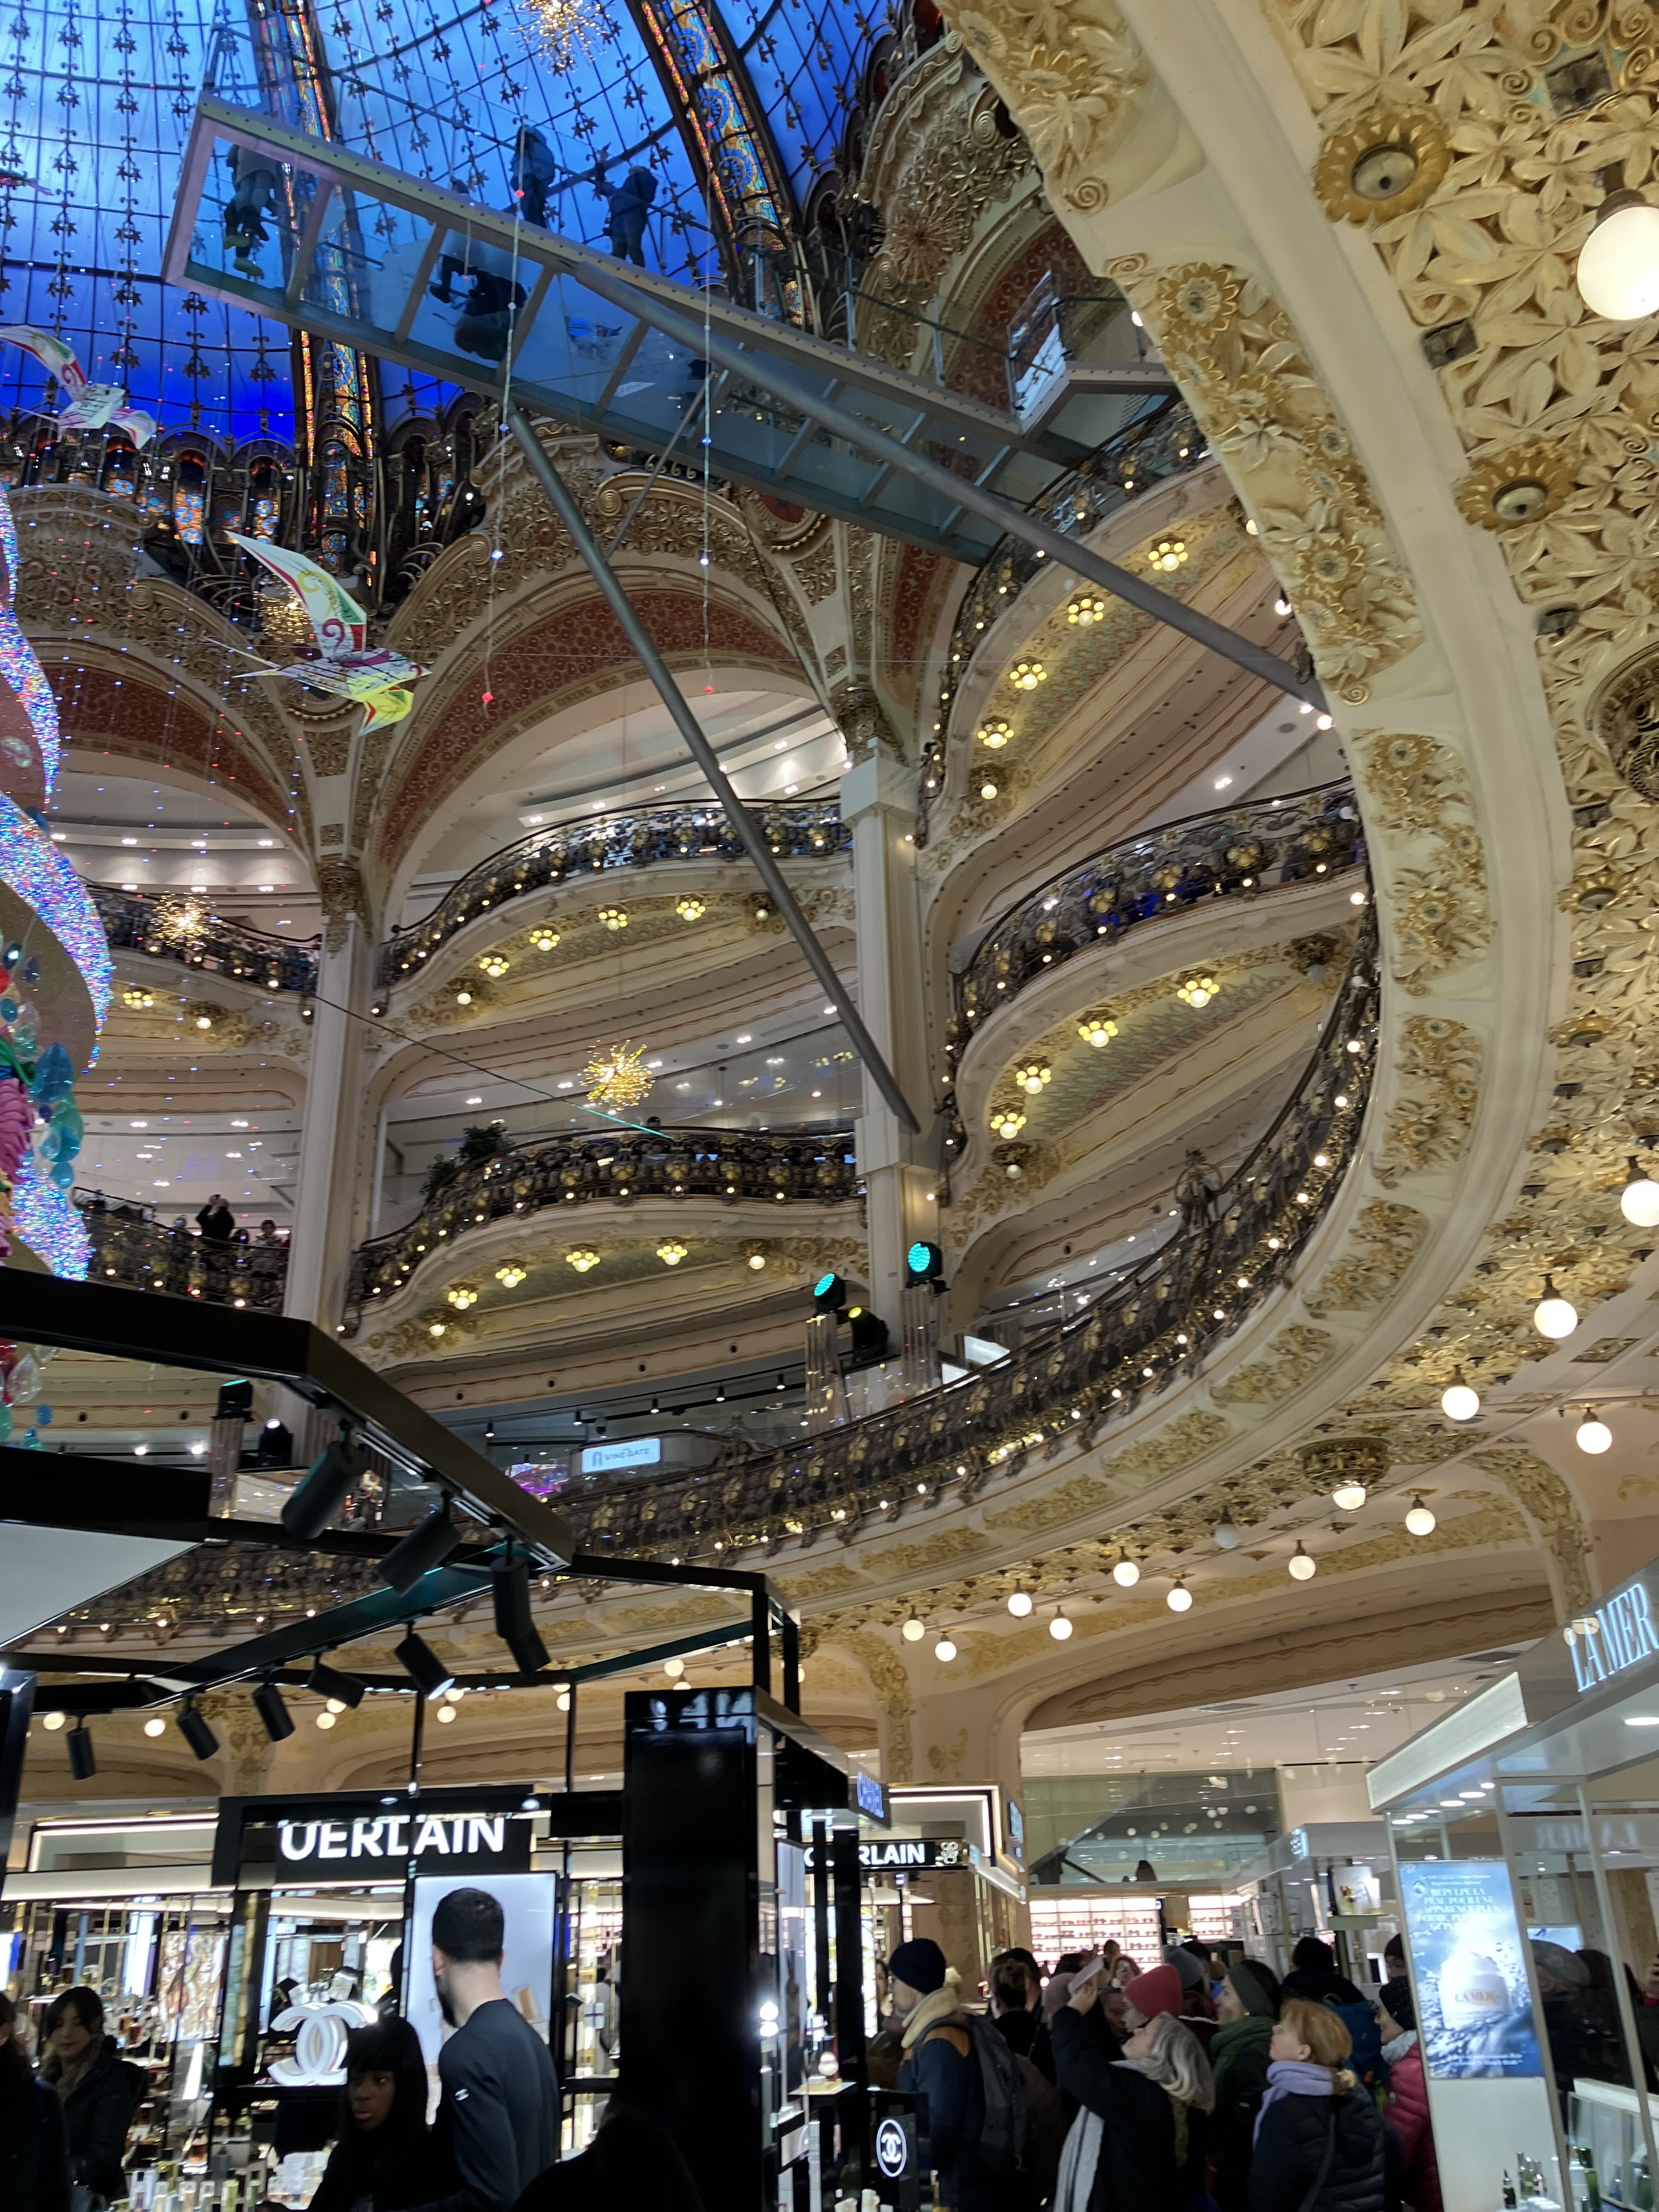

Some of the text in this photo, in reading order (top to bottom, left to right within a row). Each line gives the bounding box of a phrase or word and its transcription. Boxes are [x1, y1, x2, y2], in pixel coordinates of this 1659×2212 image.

[627, 1448, 650, 1457] GATE
[1567, 1583, 1659, 1692] LA MER
[280, 1816, 505, 1861] UERLAIN
